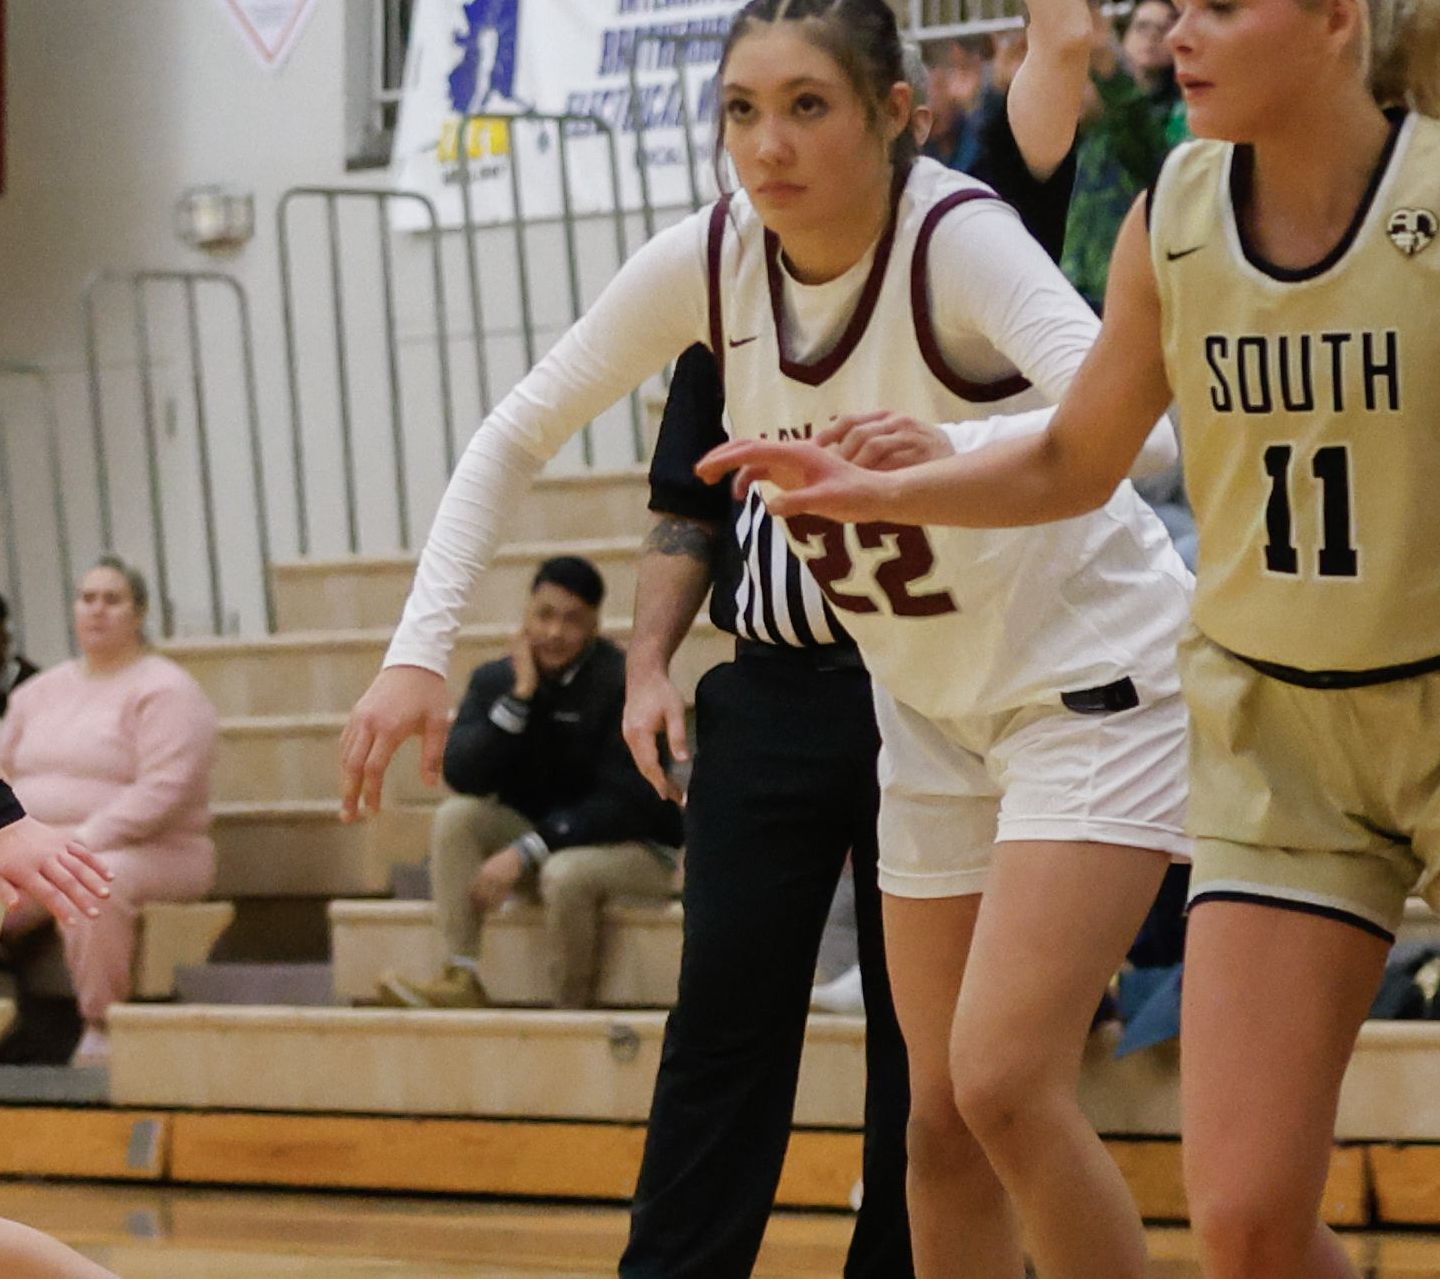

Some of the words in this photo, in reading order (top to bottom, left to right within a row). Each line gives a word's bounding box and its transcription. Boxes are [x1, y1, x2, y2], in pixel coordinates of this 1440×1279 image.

[1204, 331, 1399, 413] SOUTH
[1264, 445, 1358, 577] 11
[783, 513, 959, 617] 22
